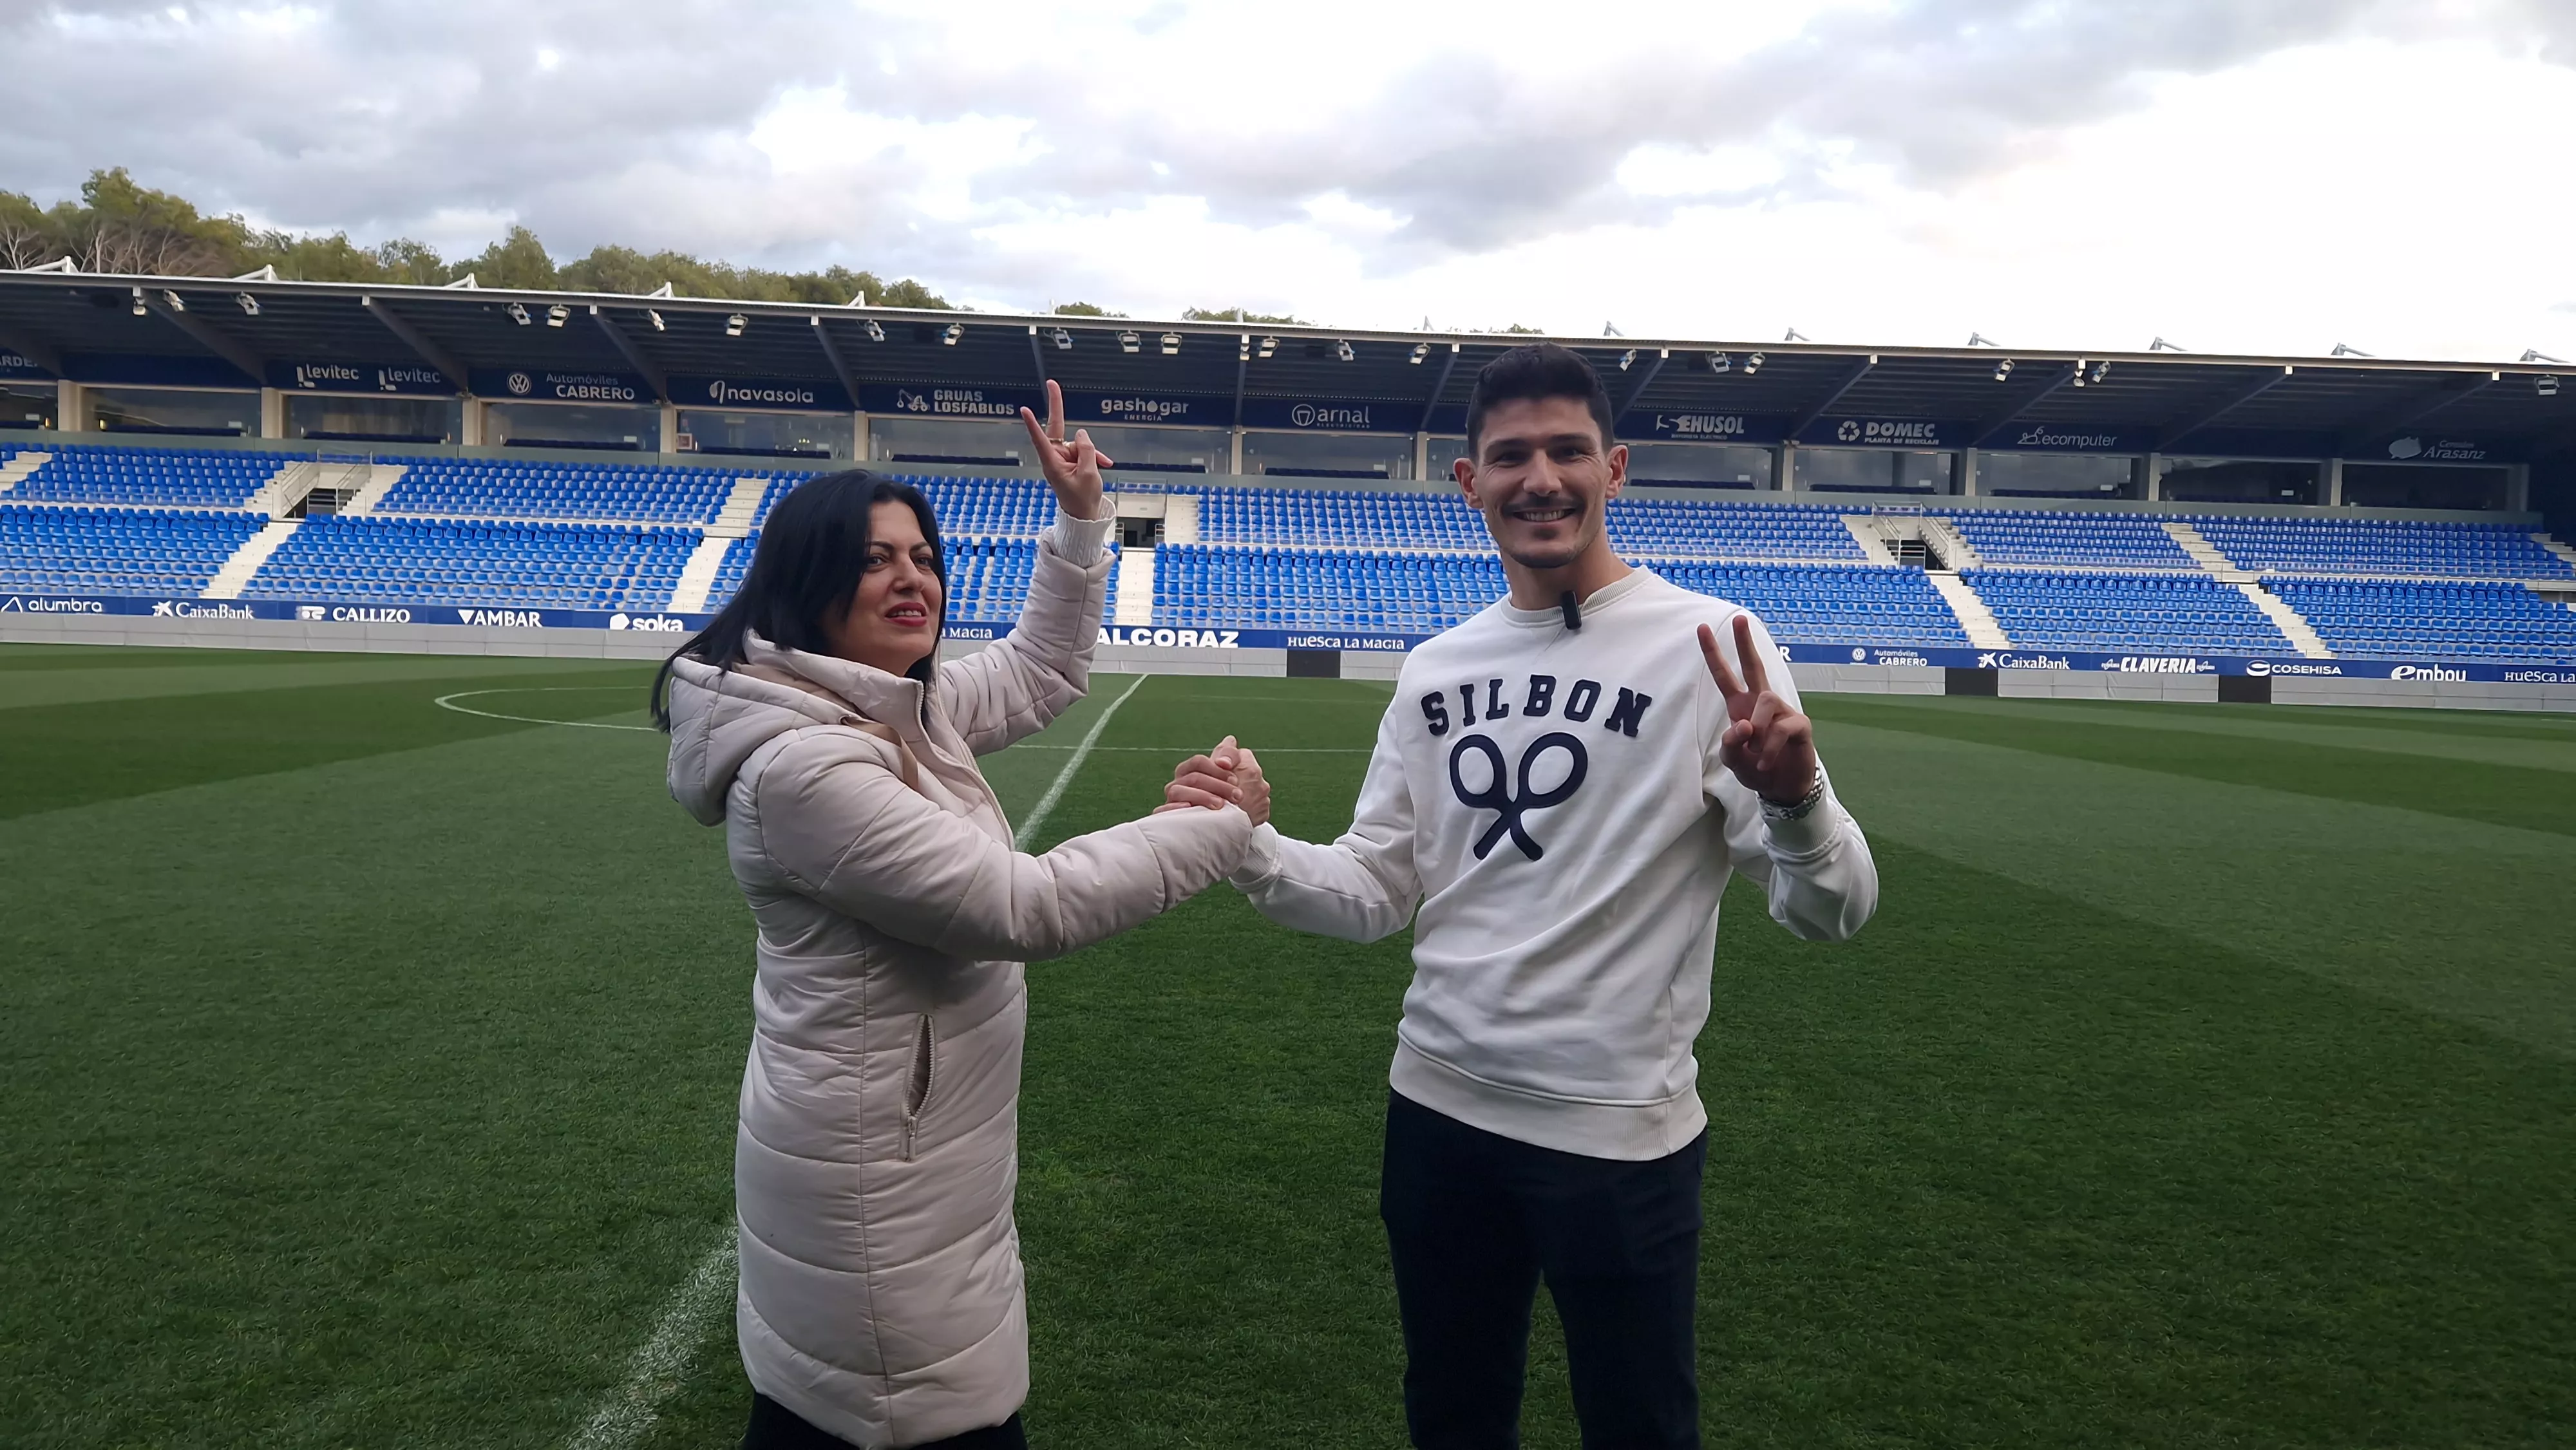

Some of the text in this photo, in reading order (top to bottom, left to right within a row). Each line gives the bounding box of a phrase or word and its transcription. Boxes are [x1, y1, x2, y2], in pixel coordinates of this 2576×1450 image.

[556, 385, 635, 400] CABRERO
[728, 388, 814, 404] navasola
[934, 389, 983, 402] GRUAS
[934, 401, 1015, 415] LOSFABLOS
[1101, 397, 1189, 416] gashogar
[1317, 406, 1370, 424] arnal
[1865, 422, 1935, 438] DOMEC
[2041, 433, 2117, 449] ecomputer
[2423, 446, 2486, 460] Arasanz
[28, 598, 102, 612] alumbra
[175, 602, 254, 619] CaixaBank
[332, 607, 411, 623] CALLIZO
[474, 610, 544, 628] AMBAR
[632, 614, 683, 632] soka
[1097, 627, 1239, 648] ALCORAZ
[1873, 649, 1918, 657] Automóviles
[1879, 657, 1927, 666] CABRERO
[1998, 654, 2070, 670] CaixaBank
[2120, 657, 2196, 673] CLAVERIA
[2271, 664, 2342, 675] COSEHISA
[2391, 664, 2467, 682] embou
[1421, 674, 1652, 737] SILBON
